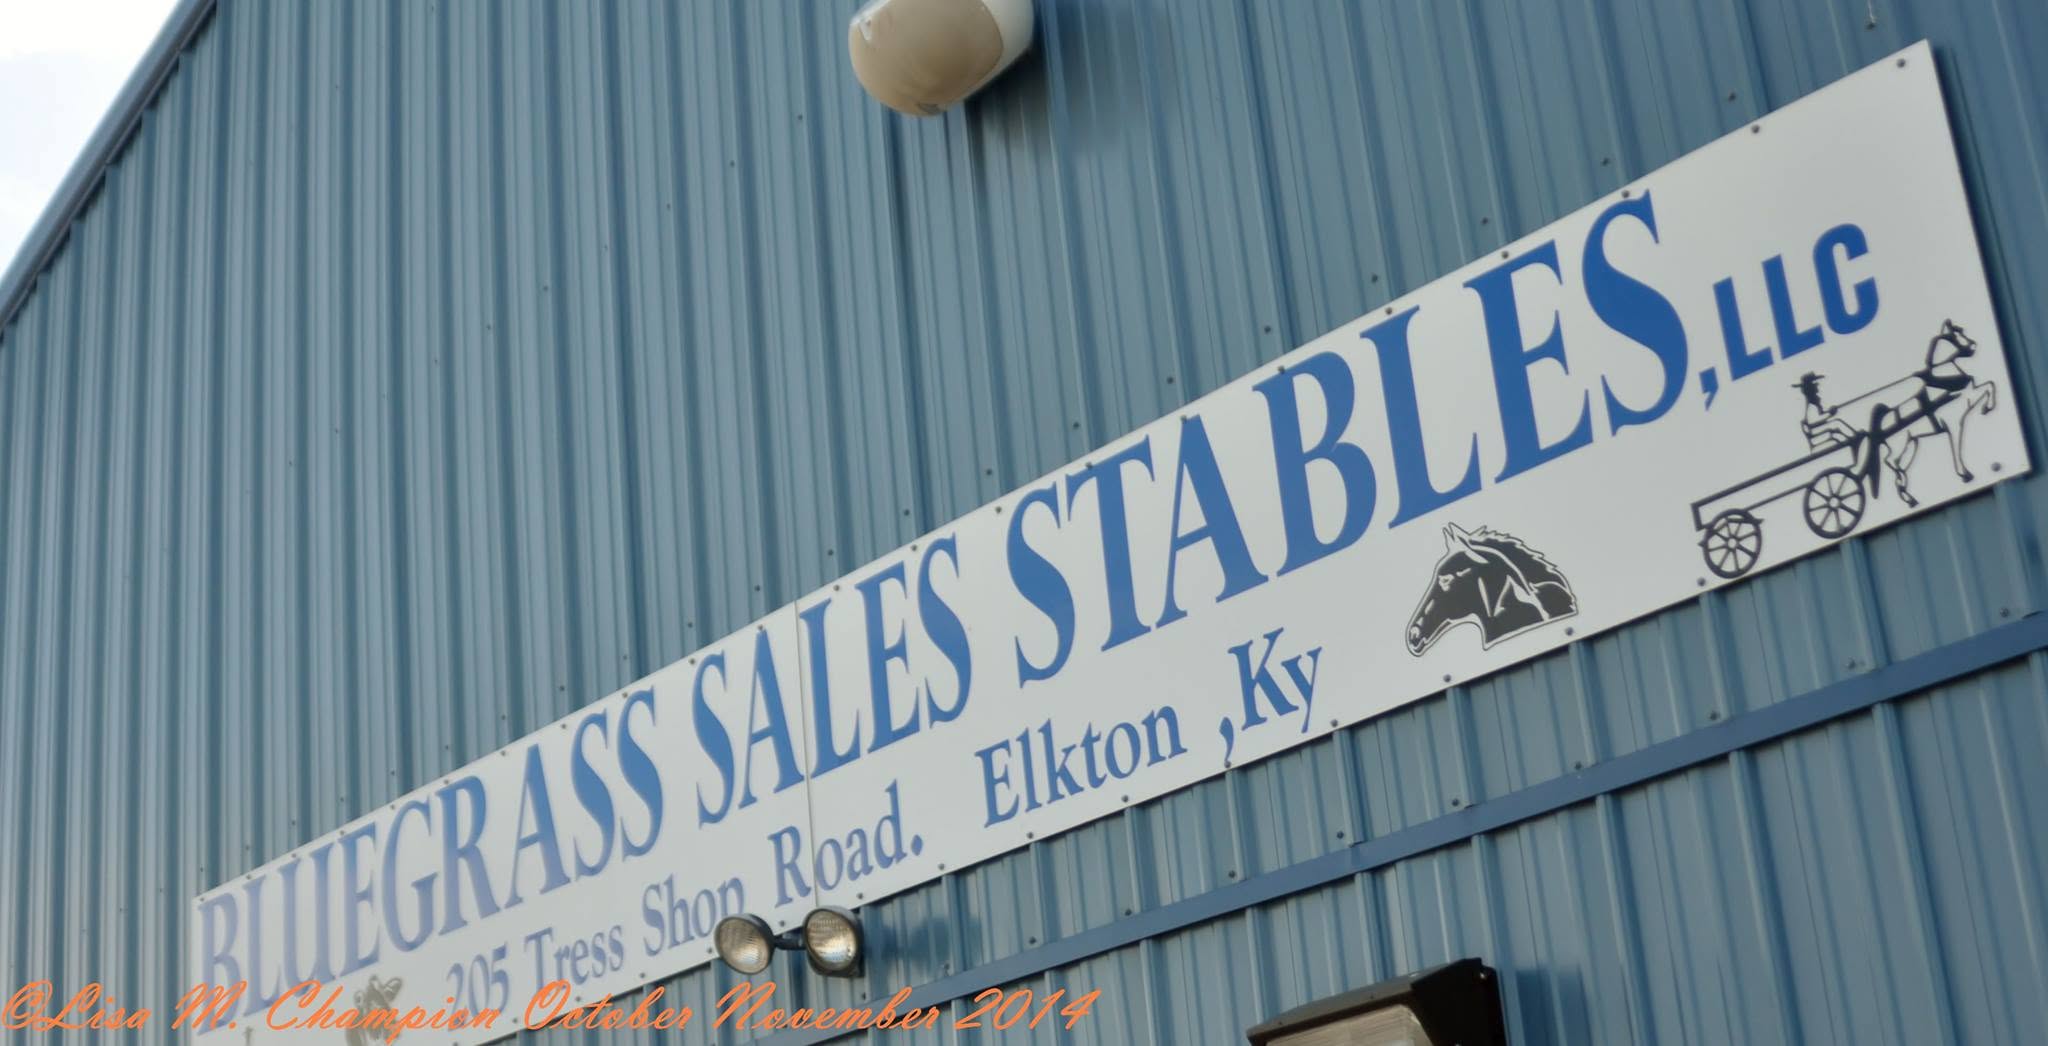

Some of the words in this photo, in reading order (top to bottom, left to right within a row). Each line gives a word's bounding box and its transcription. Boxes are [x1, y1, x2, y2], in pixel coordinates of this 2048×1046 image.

[197, 693, 665, 1036] BLUEGRASS
[691, 532, 973, 829] SALES
[446, 942, 510, 1031] 205
[524, 925, 624, 1000] Tress
[766, 780, 924, 909] Road.
[974, 703, 1187, 828] Elkton
